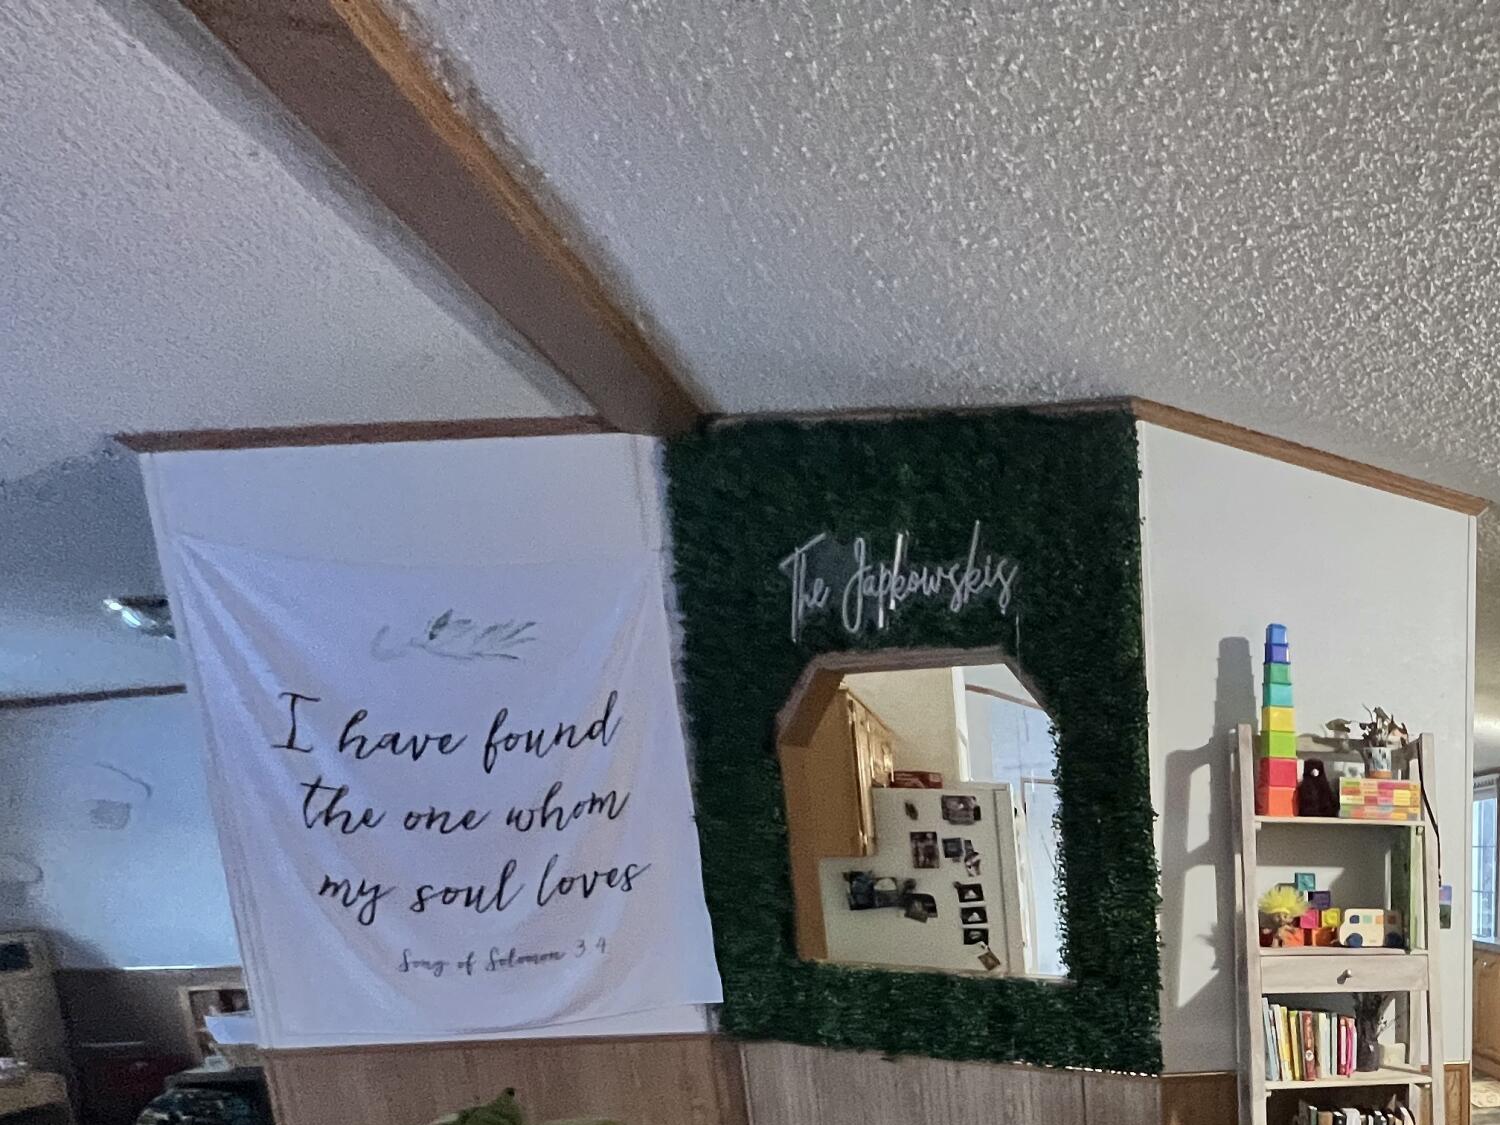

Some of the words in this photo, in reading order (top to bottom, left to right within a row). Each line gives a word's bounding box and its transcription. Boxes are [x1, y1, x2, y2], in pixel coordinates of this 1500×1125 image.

[779, 532, 829, 644] The
[271, 691, 322, 753] I
[338, 709, 468, 760] have
[482, 690, 622, 774] found
[299, 775, 387, 834] the
[403, 804, 492, 834] one
[506, 780, 631, 832] whom
[318, 864, 399, 926] my
[410, 859, 525, 913] soul
[537, 853, 652, 906] loves
[399, 948, 450, 978] Song
[457, 951, 475, 976] of
[485, 946, 565, 972] Solomon
